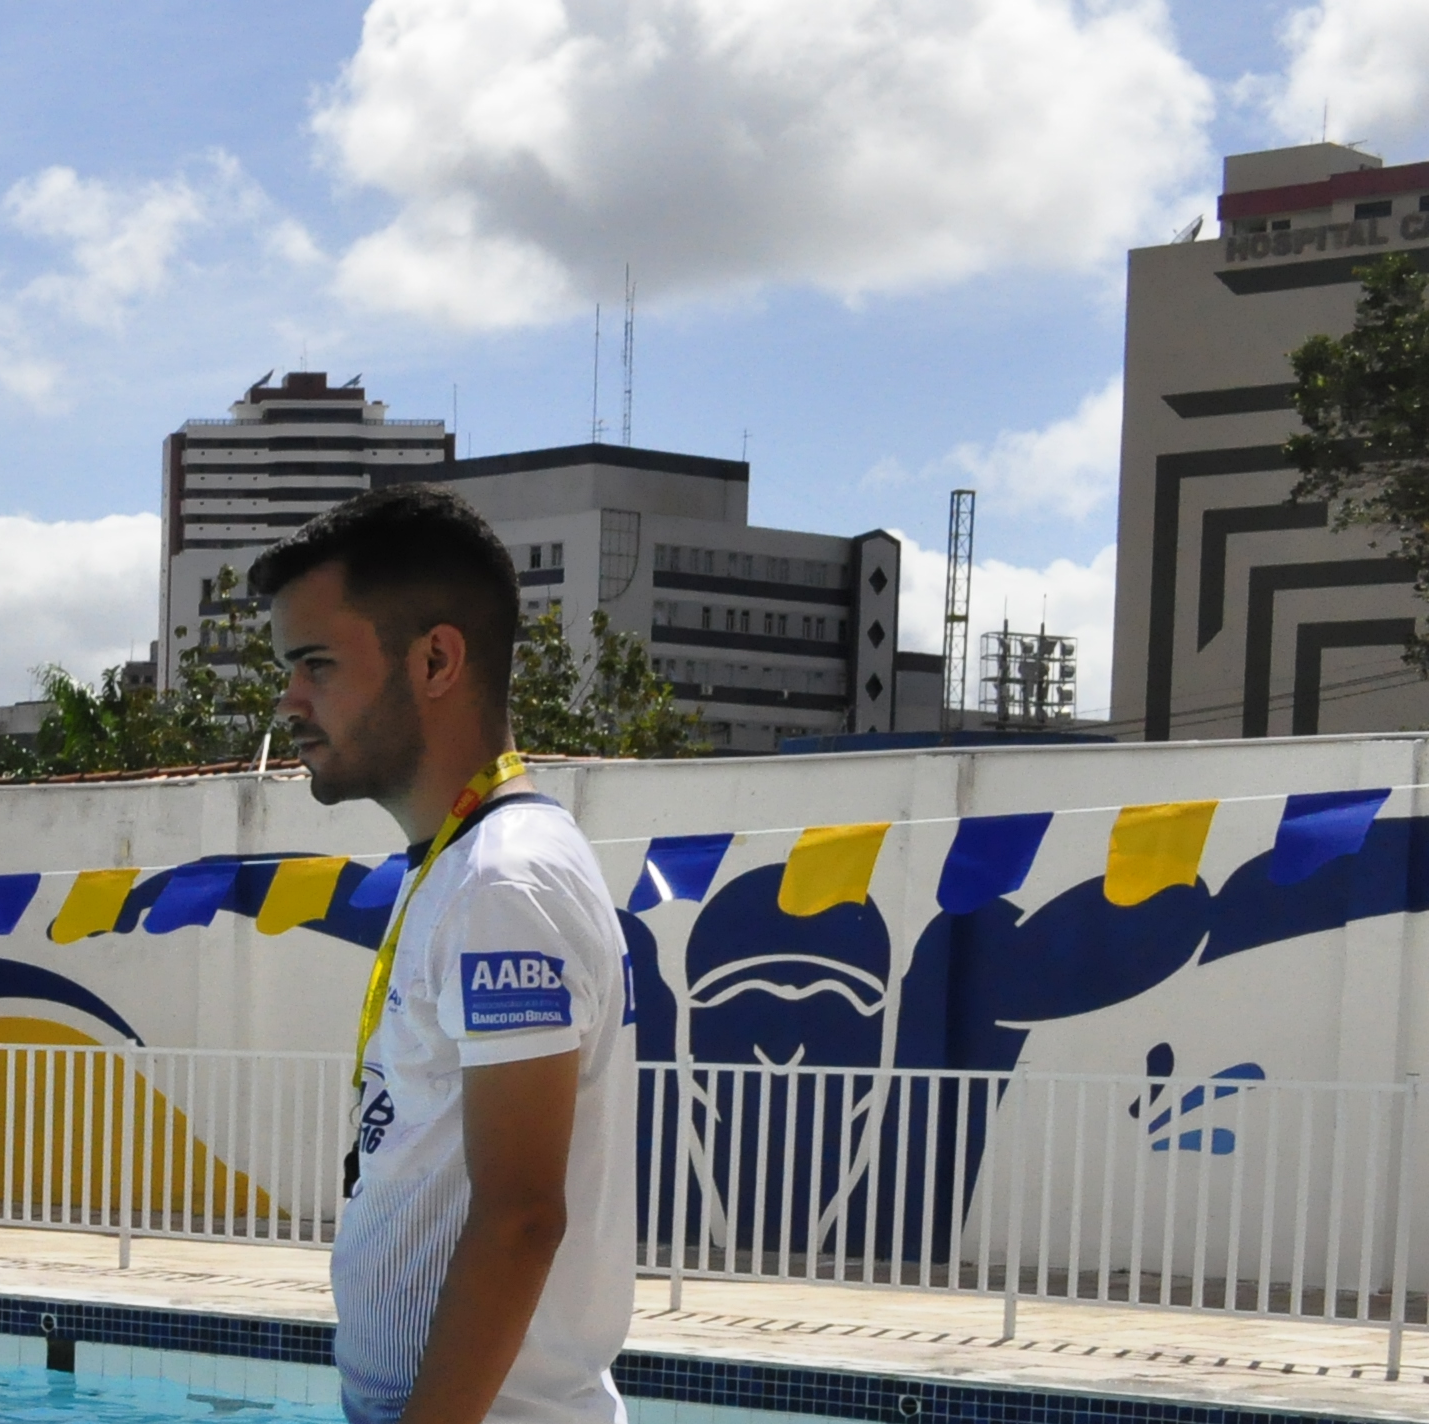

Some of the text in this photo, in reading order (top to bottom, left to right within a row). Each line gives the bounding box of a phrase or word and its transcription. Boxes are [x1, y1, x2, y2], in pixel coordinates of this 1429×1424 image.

[1225, 216, 1389, 263] HOSPITAL
[471, 1009, 564, 1025] BANCO DO BRASIL
